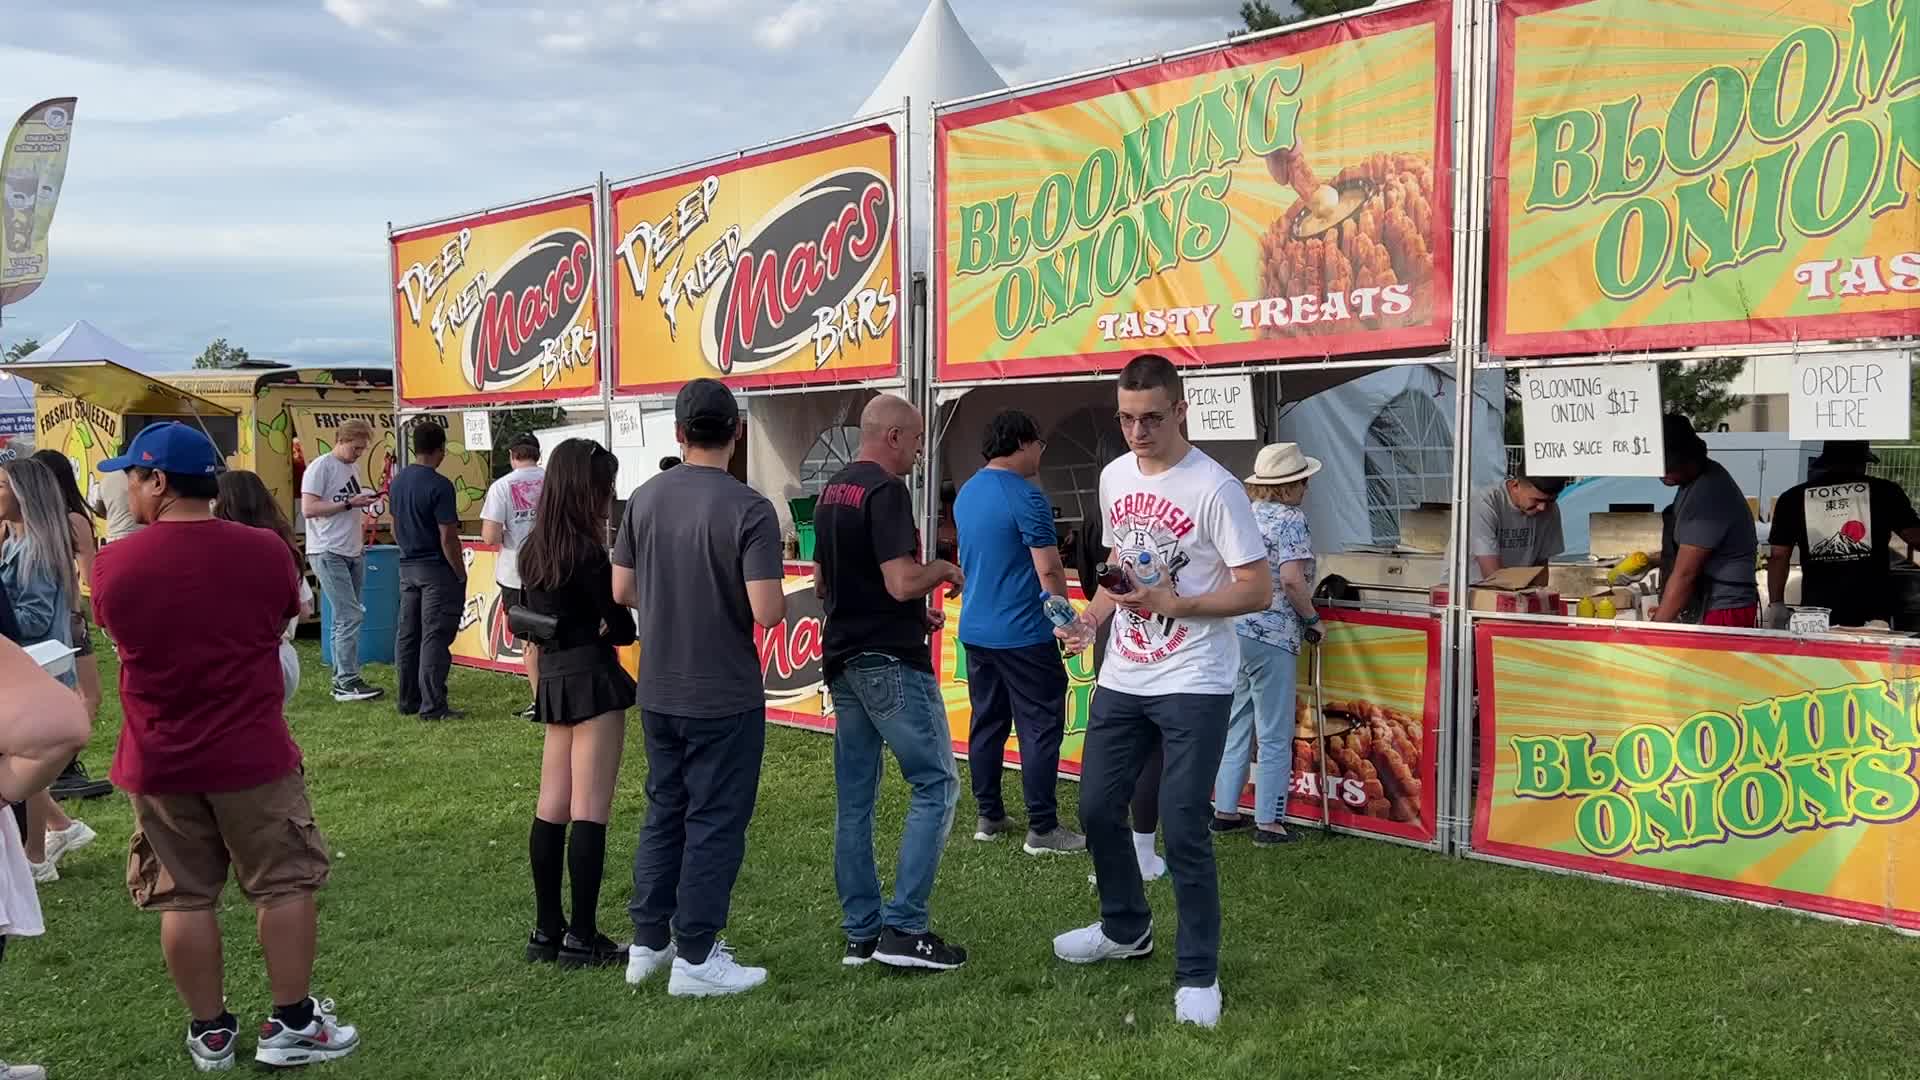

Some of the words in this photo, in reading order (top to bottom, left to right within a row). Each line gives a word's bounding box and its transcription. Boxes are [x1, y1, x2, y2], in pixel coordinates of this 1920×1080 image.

[955, 63, 1304, 277] BLOOMING
[616, 175, 720, 298] DEEP
[994, 170, 1232, 340] ONIONS
[397, 228, 472, 327] DEEP
[659, 224, 741, 342] FRIED
[719, 182, 885, 374] Mars
[431, 271, 488, 363] FRIED
[475, 241, 589, 390] Mars
[812, 277, 897, 370] BARS
[1097, 304, 1220, 340] TASTY
[1233, 283, 1413, 331] TREATS
[539, 318, 597, 390] BARS
[1802, 363, 1883, 396] ORDER
[40, 401, 73, 435] FRESHLY
[74, 400, 116, 438] SQUEEZED
[1188, 386, 1241, 405] PICK-UP
[1201, 410, 1236, 430] HERE
[1529, 377, 1601, 400] BLOOMING
[1607, 388, 1639, 416] $17
[1551, 402, 1595, 423] ONION
[1815, 398, 1869, 429] HERE
[1534, 442, 1567, 459] EXTRA
[1572, 440, 1602, 455] SAUCE
[1612, 440, 1629, 453] FOR
[1632, 436, 1651, 455] $1
[1808, 483, 1866, 498] TOKYO
[1825, 499, 1849, 511] 東京
[1135, 532, 1145, 546] 13
[753, 616, 824, 682] Ma
[1510, 676, 1920, 798] BLOOMIN
[1575, 747, 1920, 856] ONIONS
